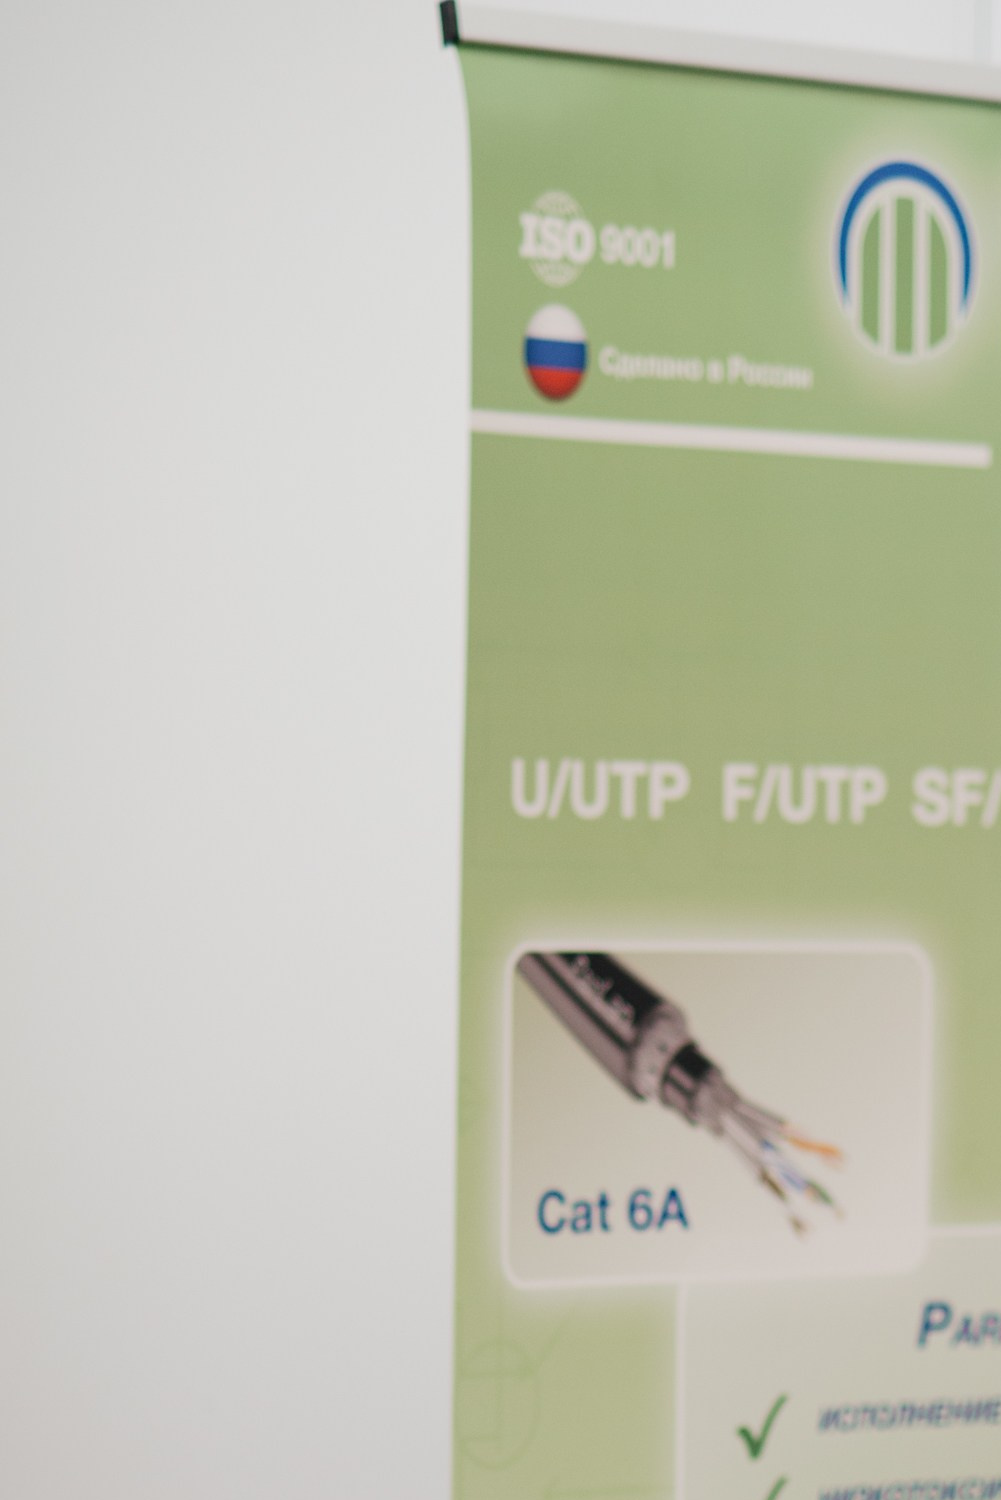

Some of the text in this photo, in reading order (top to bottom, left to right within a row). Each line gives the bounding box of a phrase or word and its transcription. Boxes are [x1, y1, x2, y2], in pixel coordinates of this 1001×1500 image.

[519, 212, 676, 270] ISO 9001
[598, 346, 704, 382] Сделано
[511, 757, 692, 820] U/UTP
[721, 762, 888, 825] F/UTP
[537, 1186, 689, 1234] Cat 6A
